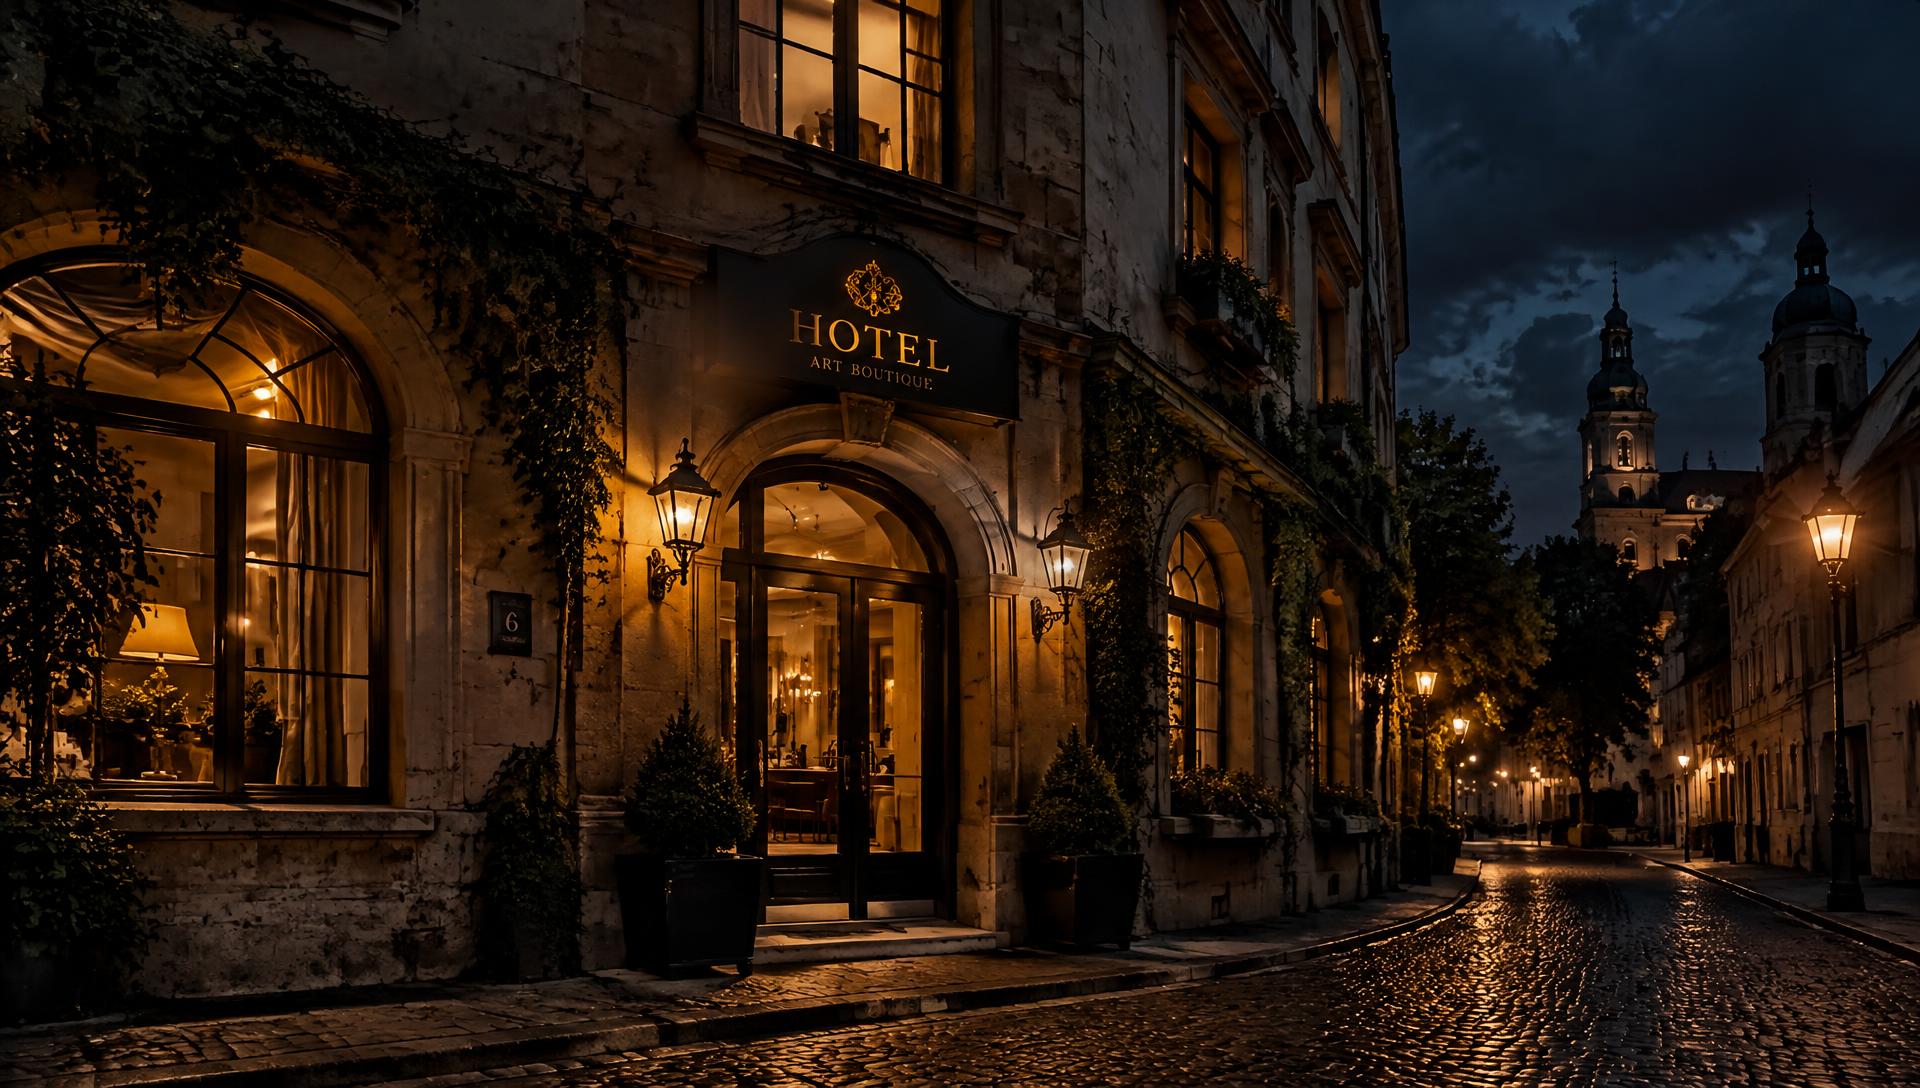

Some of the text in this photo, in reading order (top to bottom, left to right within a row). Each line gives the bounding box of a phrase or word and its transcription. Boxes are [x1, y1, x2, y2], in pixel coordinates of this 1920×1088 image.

[789, 308, 950, 373] HOTEL
[810, 355, 933, 391] ART BOUTIQUE
[505, 611, 519, 633] 6
